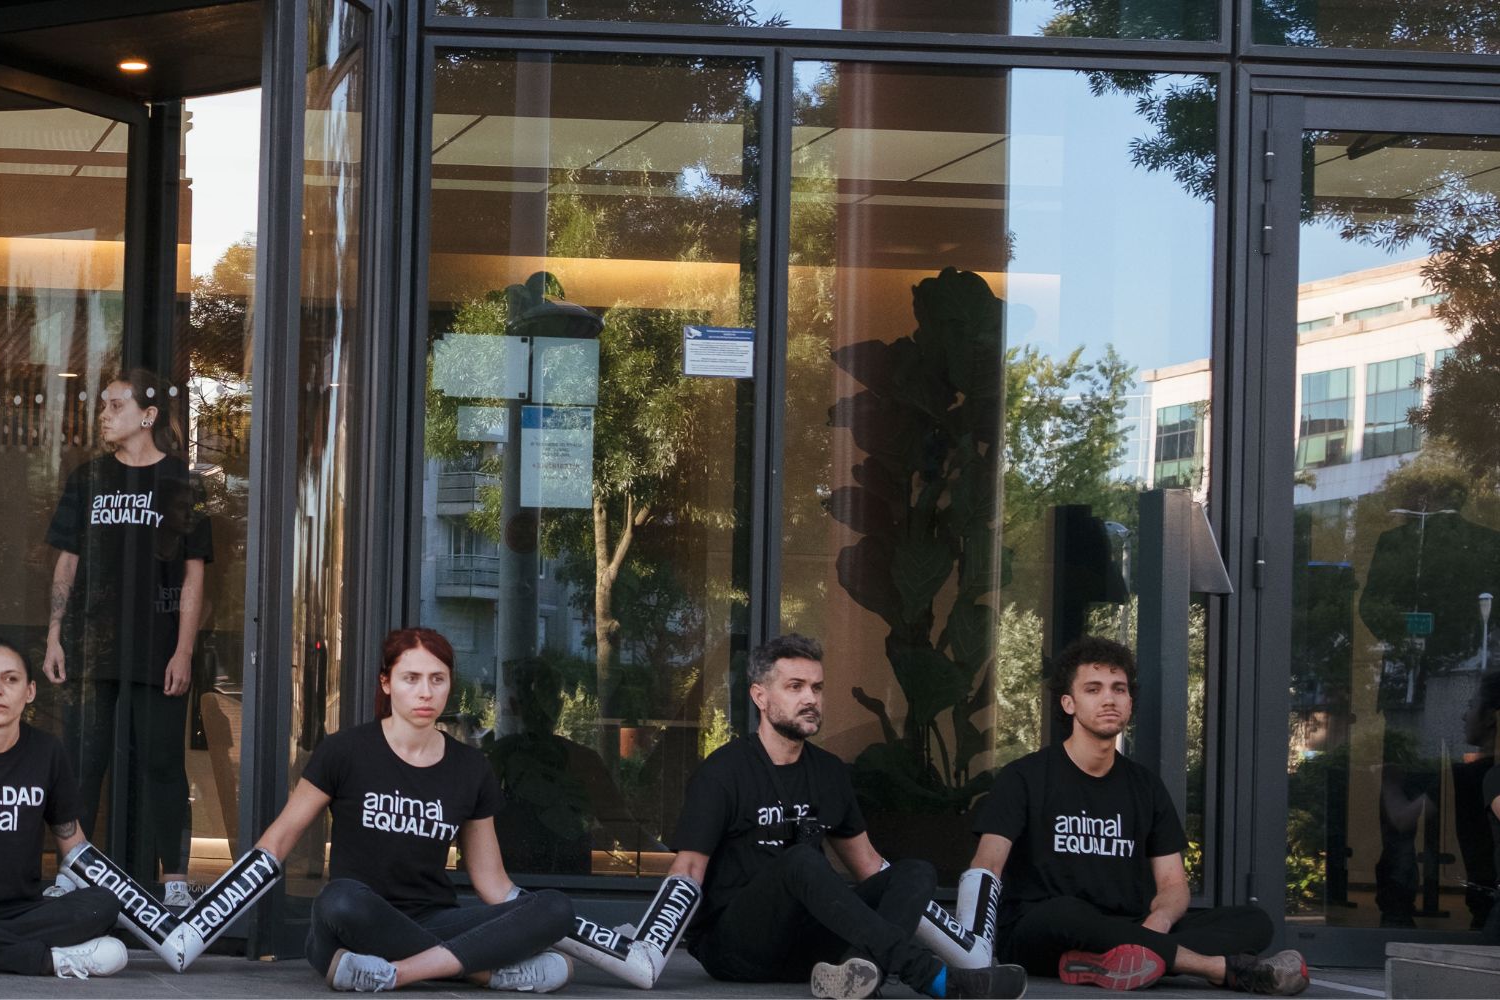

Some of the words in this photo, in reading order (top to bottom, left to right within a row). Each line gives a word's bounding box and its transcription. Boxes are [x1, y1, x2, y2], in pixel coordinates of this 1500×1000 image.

[92, 490, 152, 509] animal
[90, 508, 164, 528] EQUALITY
[363, 789, 443, 821] animal
[362, 809, 459, 841] EQUALITY
[1053, 810, 1121, 837] animal
[1053, 834, 1135, 857] EQUALITY
[85, 859, 170, 932] animal
[189, 853, 275, 939] EQUALITY
[643, 880, 696, 951] EQUALITY
[926, 900, 966, 940] mal
[575, 916, 621, 950] mal
